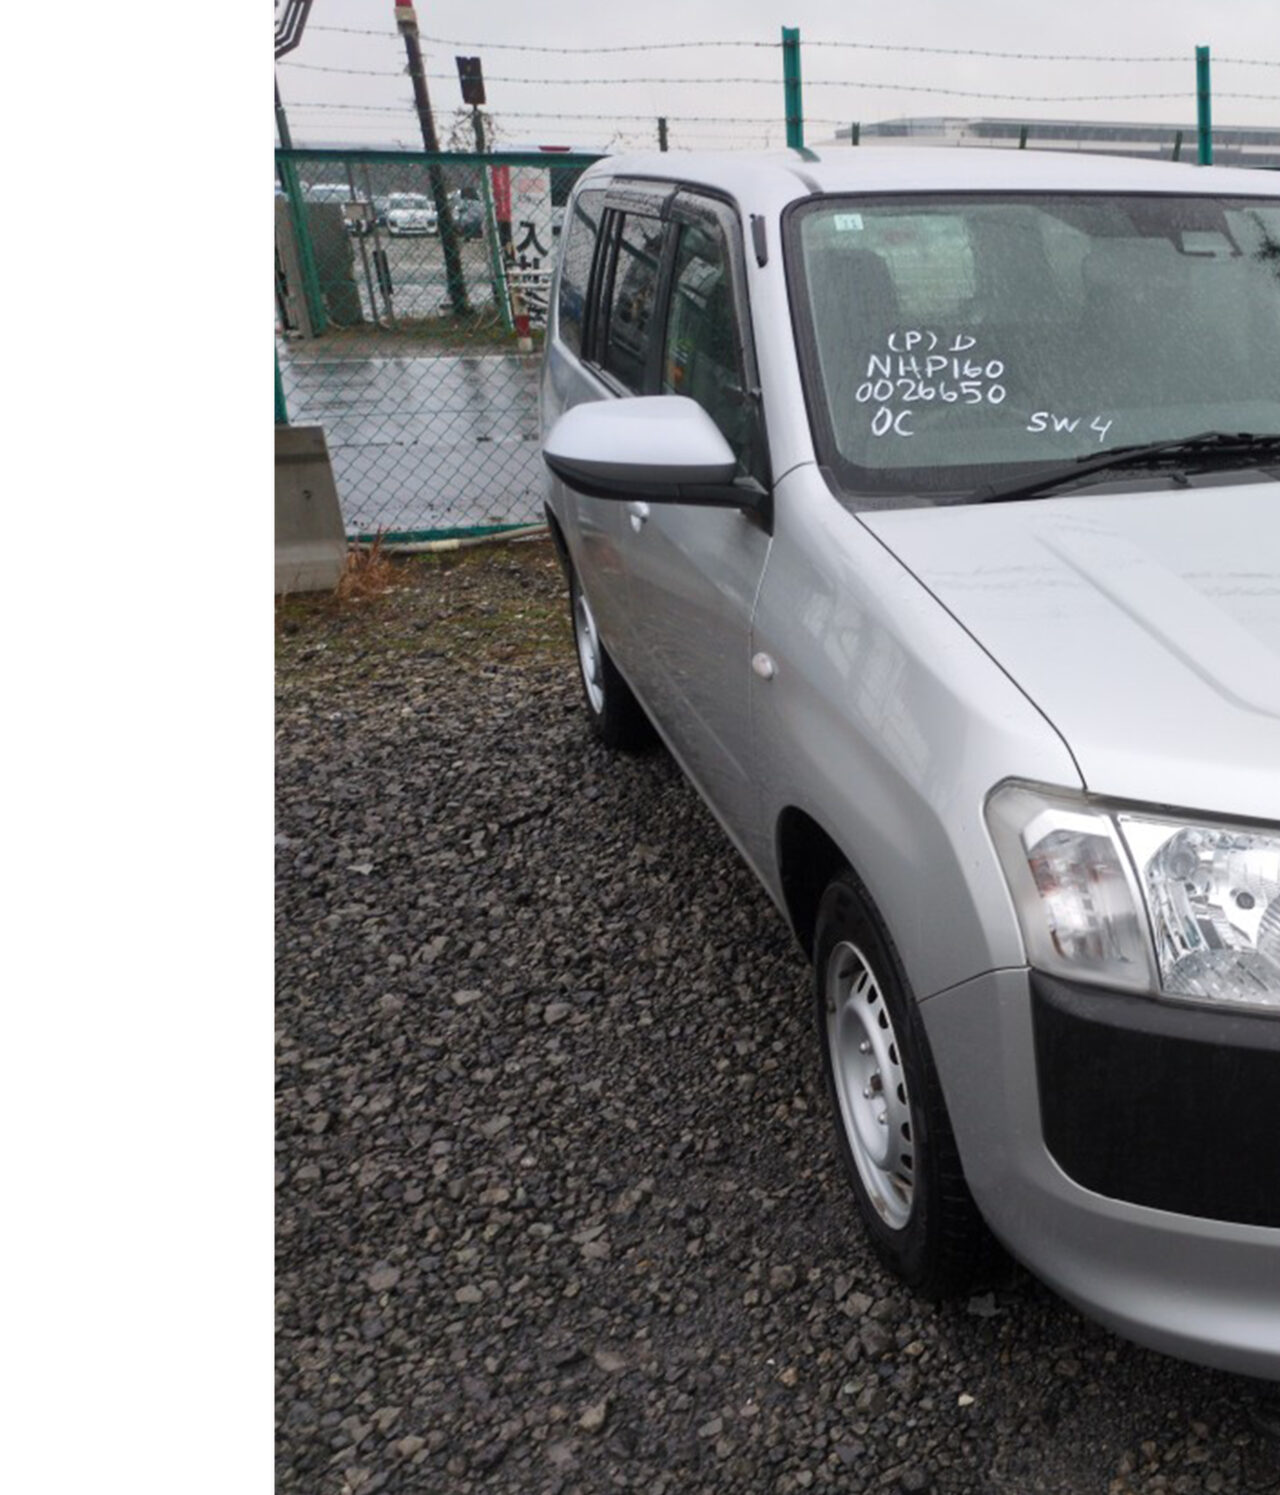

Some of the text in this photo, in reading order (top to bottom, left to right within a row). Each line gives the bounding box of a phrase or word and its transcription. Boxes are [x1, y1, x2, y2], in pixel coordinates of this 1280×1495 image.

[867, 355, 1004, 379] NHP160
[855, 379, 1006, 404] 0026650
[1026, 412, 1080, 433] SW
